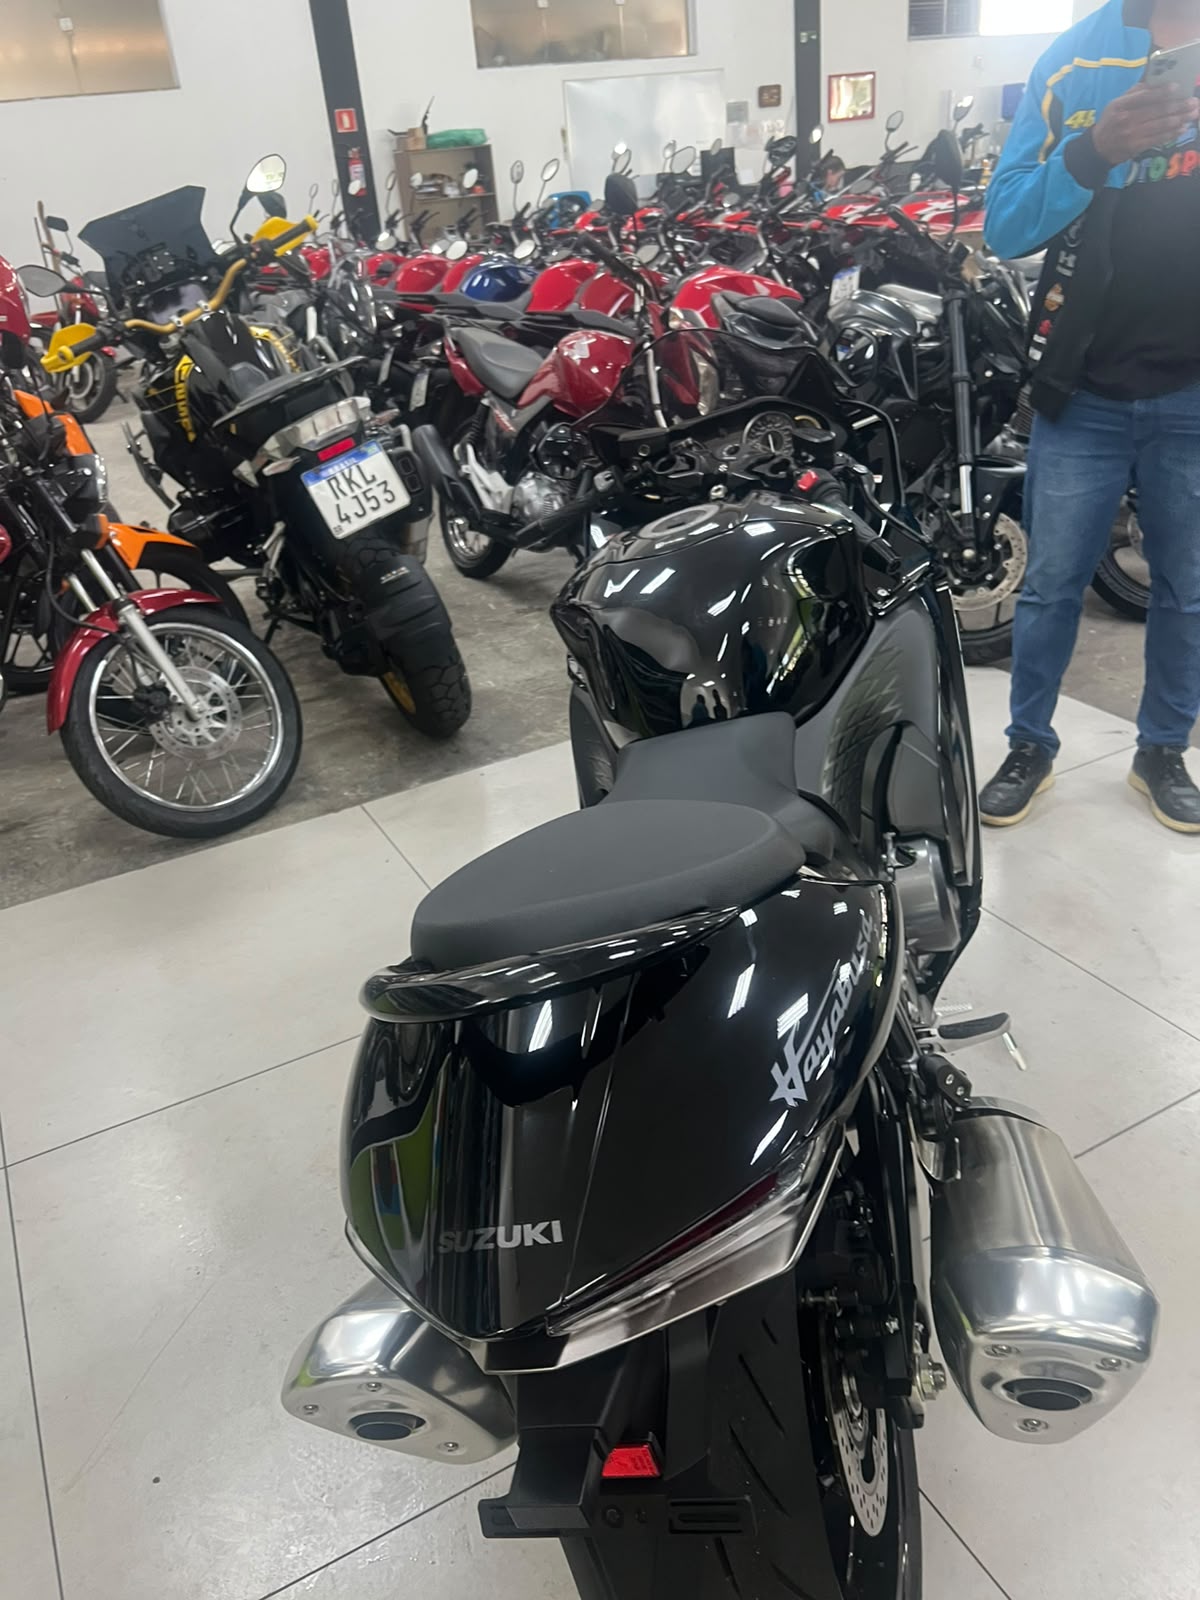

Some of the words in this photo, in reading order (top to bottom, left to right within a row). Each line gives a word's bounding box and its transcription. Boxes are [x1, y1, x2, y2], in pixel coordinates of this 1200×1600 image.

[327, 465, 377, 500] RKL
[336, 480, 396, 524] 4J53
[769, 912, 874, 1107] Hayabusa
[437, 1220, 563, 1253] SUZUKI
